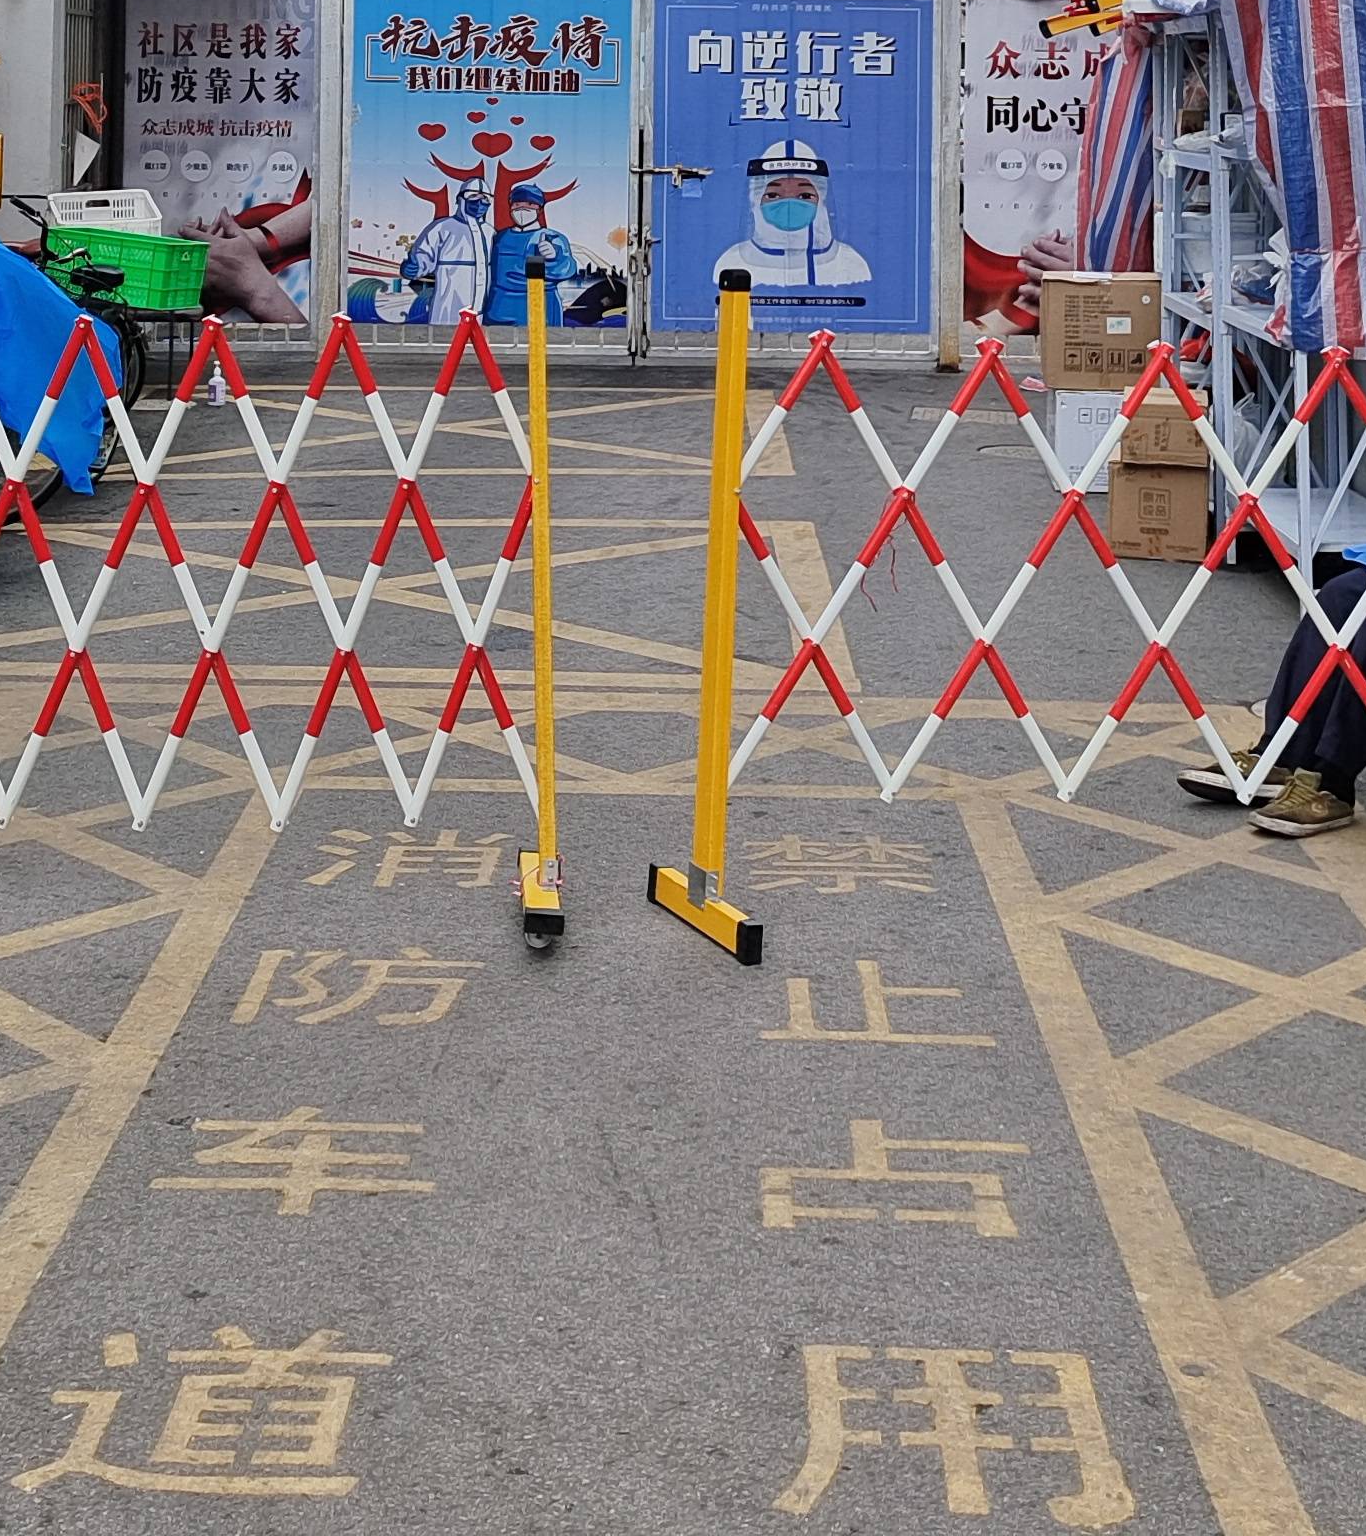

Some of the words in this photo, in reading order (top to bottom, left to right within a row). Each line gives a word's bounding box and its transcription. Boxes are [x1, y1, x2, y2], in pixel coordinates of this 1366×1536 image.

[137, 21, 301, 60] 社区是我家
[379, 14, 608, 69] 抗击疫情
[688, 29, 897, 75] 向逆行者
[137, 66, 301, 105] 防疫靠大家
[406, 65, 581, 93] 我们继续加油
[740, 77, 843, 122] 致敬
[140, 118, 215, 137] 众志成城
[219, 118, 292, 138] 抗击疫情
